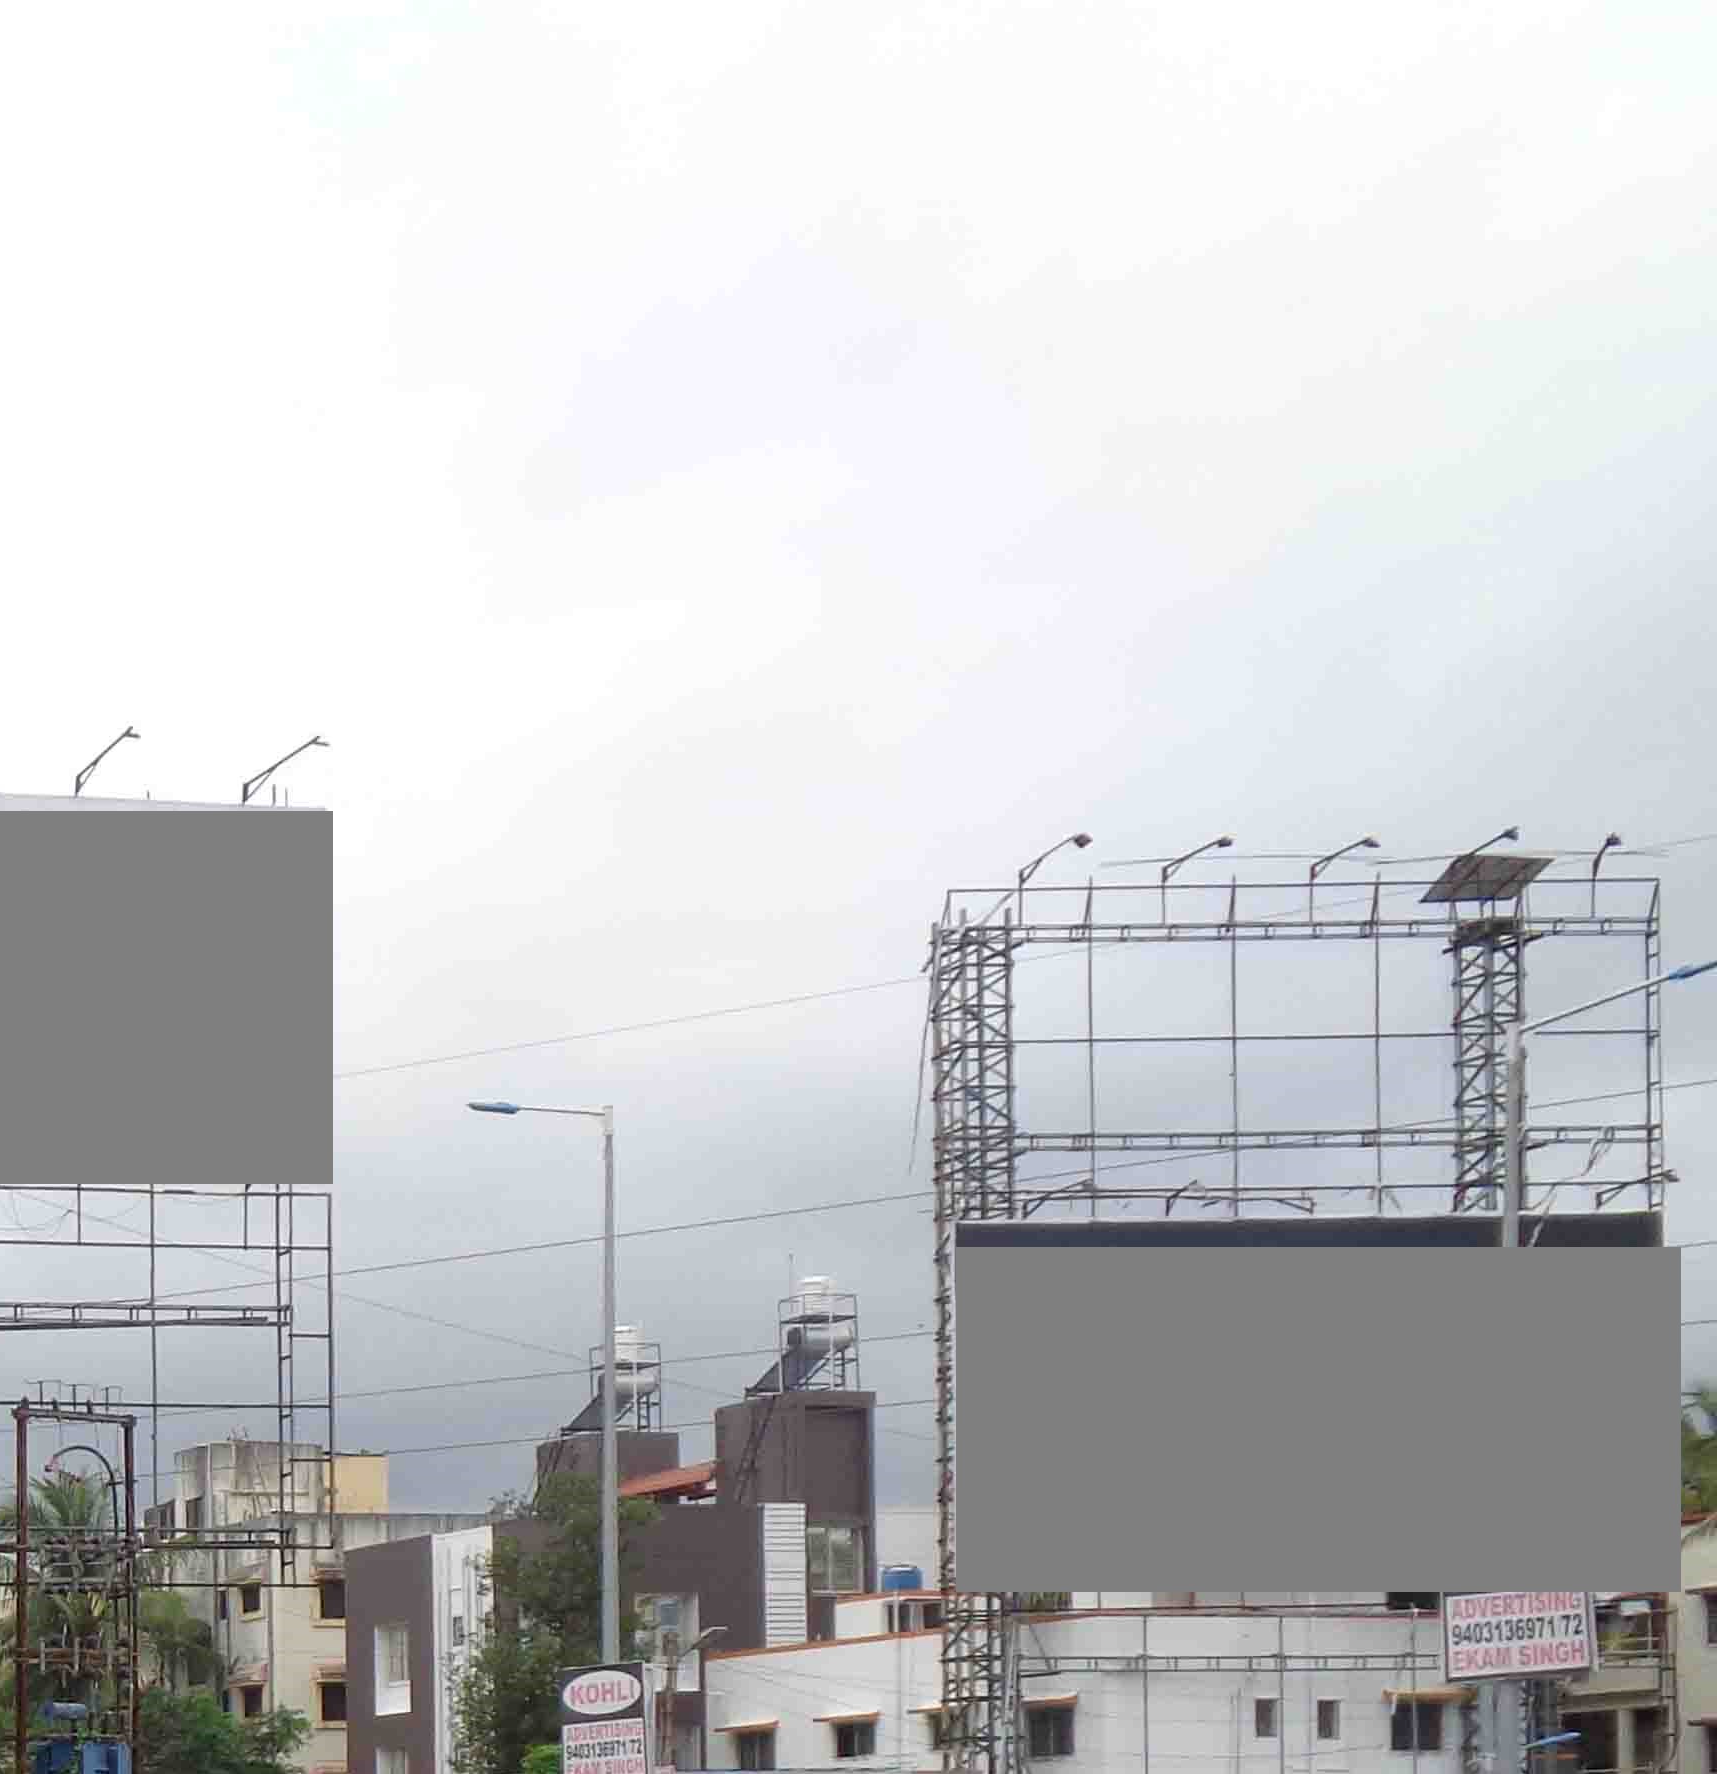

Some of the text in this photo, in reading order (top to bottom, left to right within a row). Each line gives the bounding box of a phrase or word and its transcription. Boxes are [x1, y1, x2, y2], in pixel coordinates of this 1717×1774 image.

[1452, 1592, 1582, 1618] ADVERTISING
[1561, 1613, 1583, 1635] 72
[1452, 1640, 1584, 1672] EKAM SINGH
[570, 1679, 635, 1705] KOHLI
